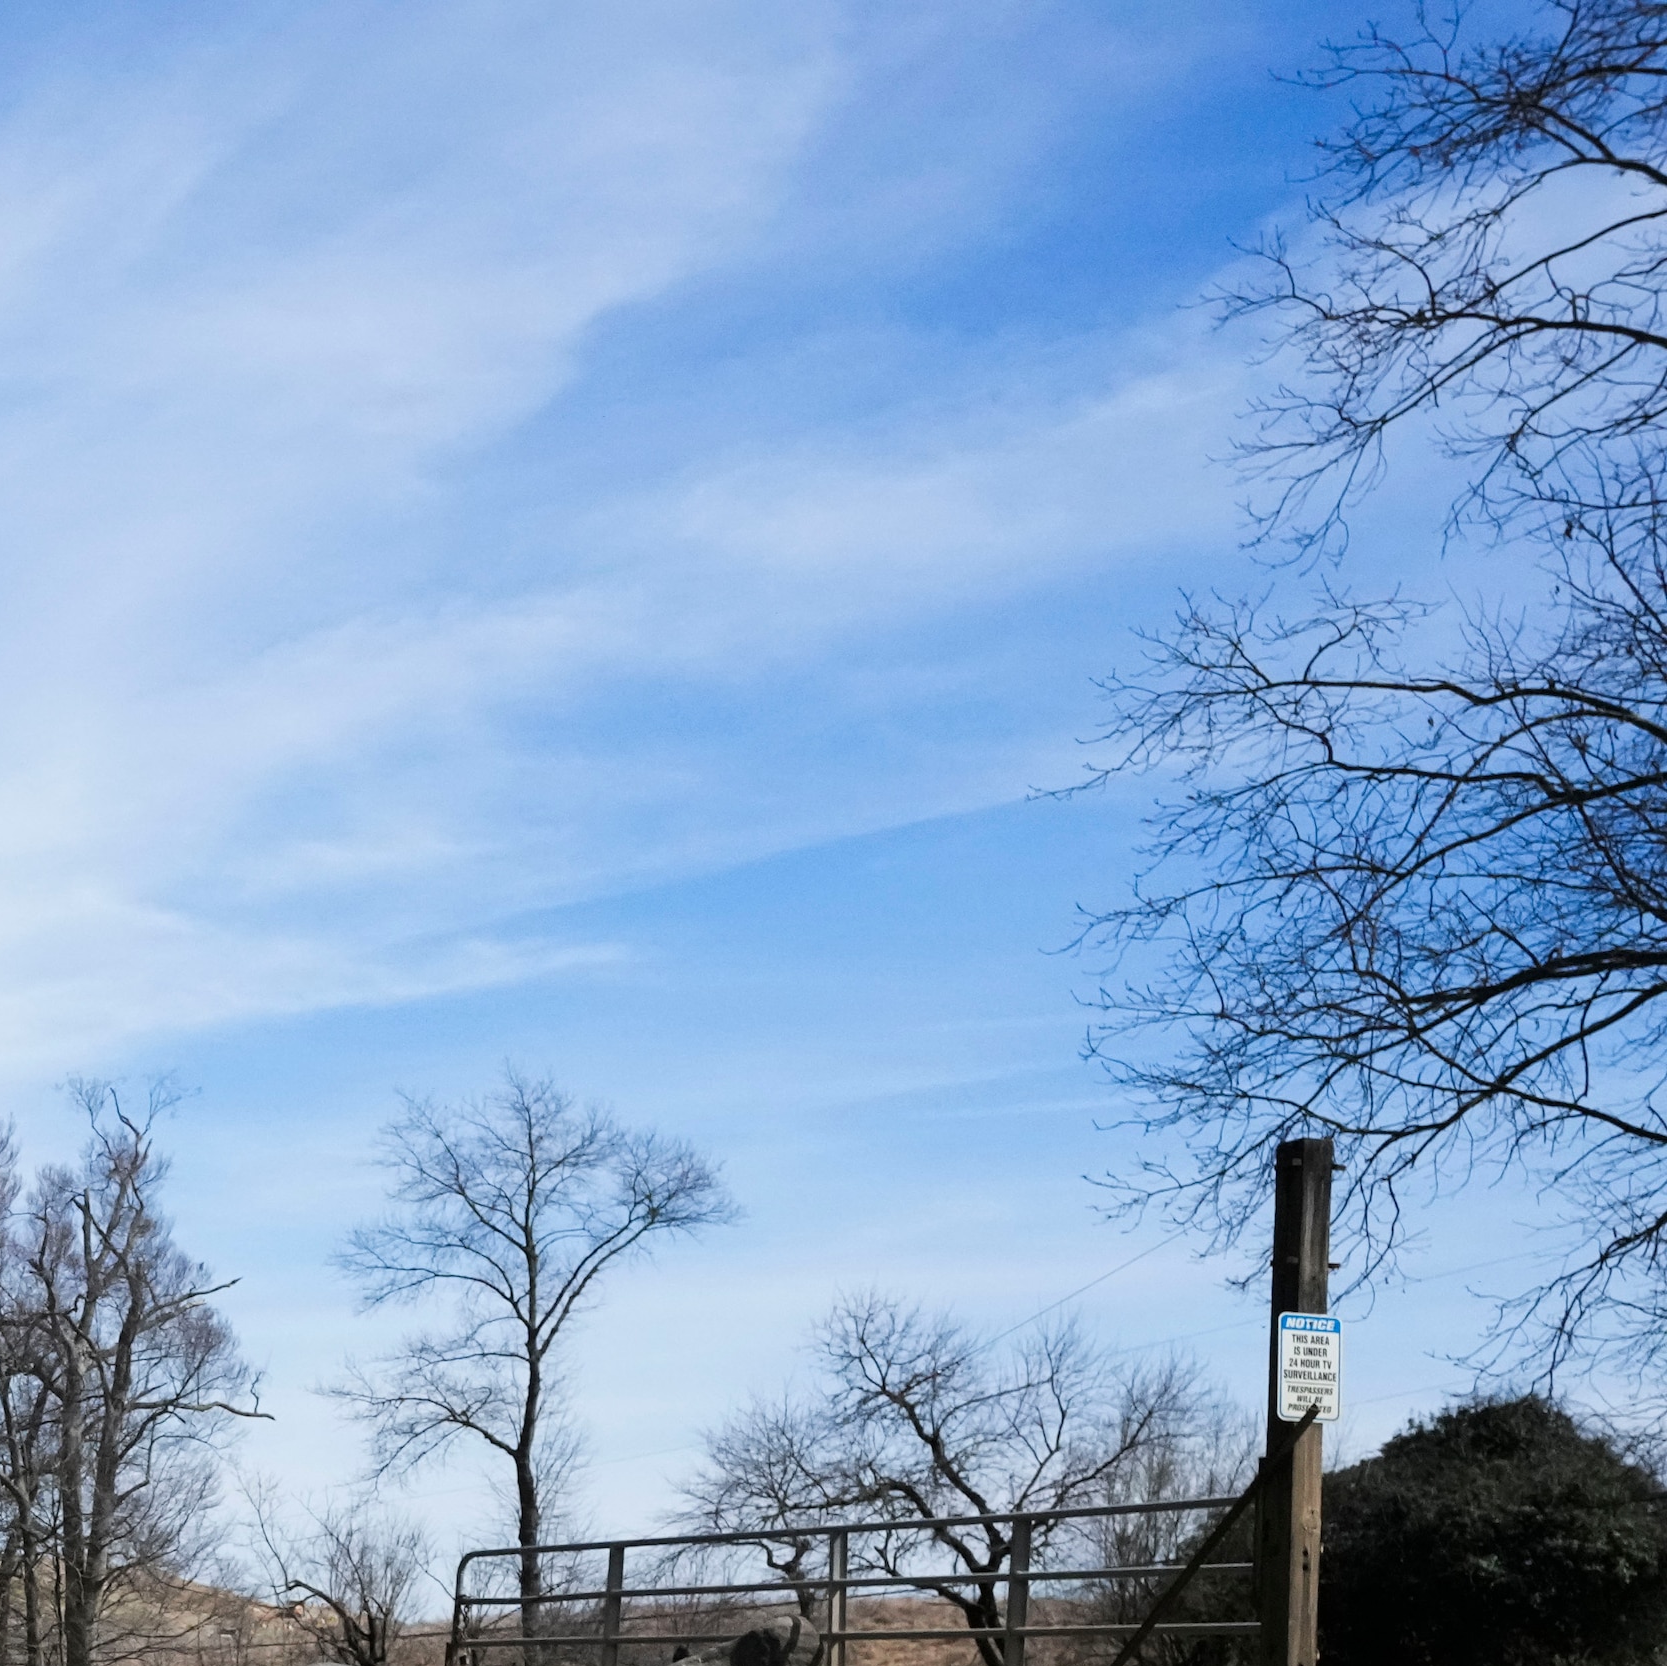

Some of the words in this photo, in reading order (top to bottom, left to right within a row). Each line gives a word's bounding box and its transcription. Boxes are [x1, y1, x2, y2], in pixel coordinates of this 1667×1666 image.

[1286, 1317, 1335, 1331] NOTICE
[1292, 1334, 1308, 1344] THIS
[1310, 1335, 1330, 1346] AREA
[1294, 1346, 1301, 1356] IS
[1303, 1347, 1328, 1358] UNDER
[1289, 1358, 1298, 1368] 24
[1300, 1358, 1320, 1369] HOUR
[1323, 1360, 1332, 1370] TV
[1283, 1369, 1337, 1382] SURVEILLANCE
[1287, 1385, 1333, 1396] TRESPASSERS
[1297, 1395, 1312, 1404] WILL
[1314, 1396, 1323, 1404] BE
[1287, 1403, 1332, 1414] PROSETED
